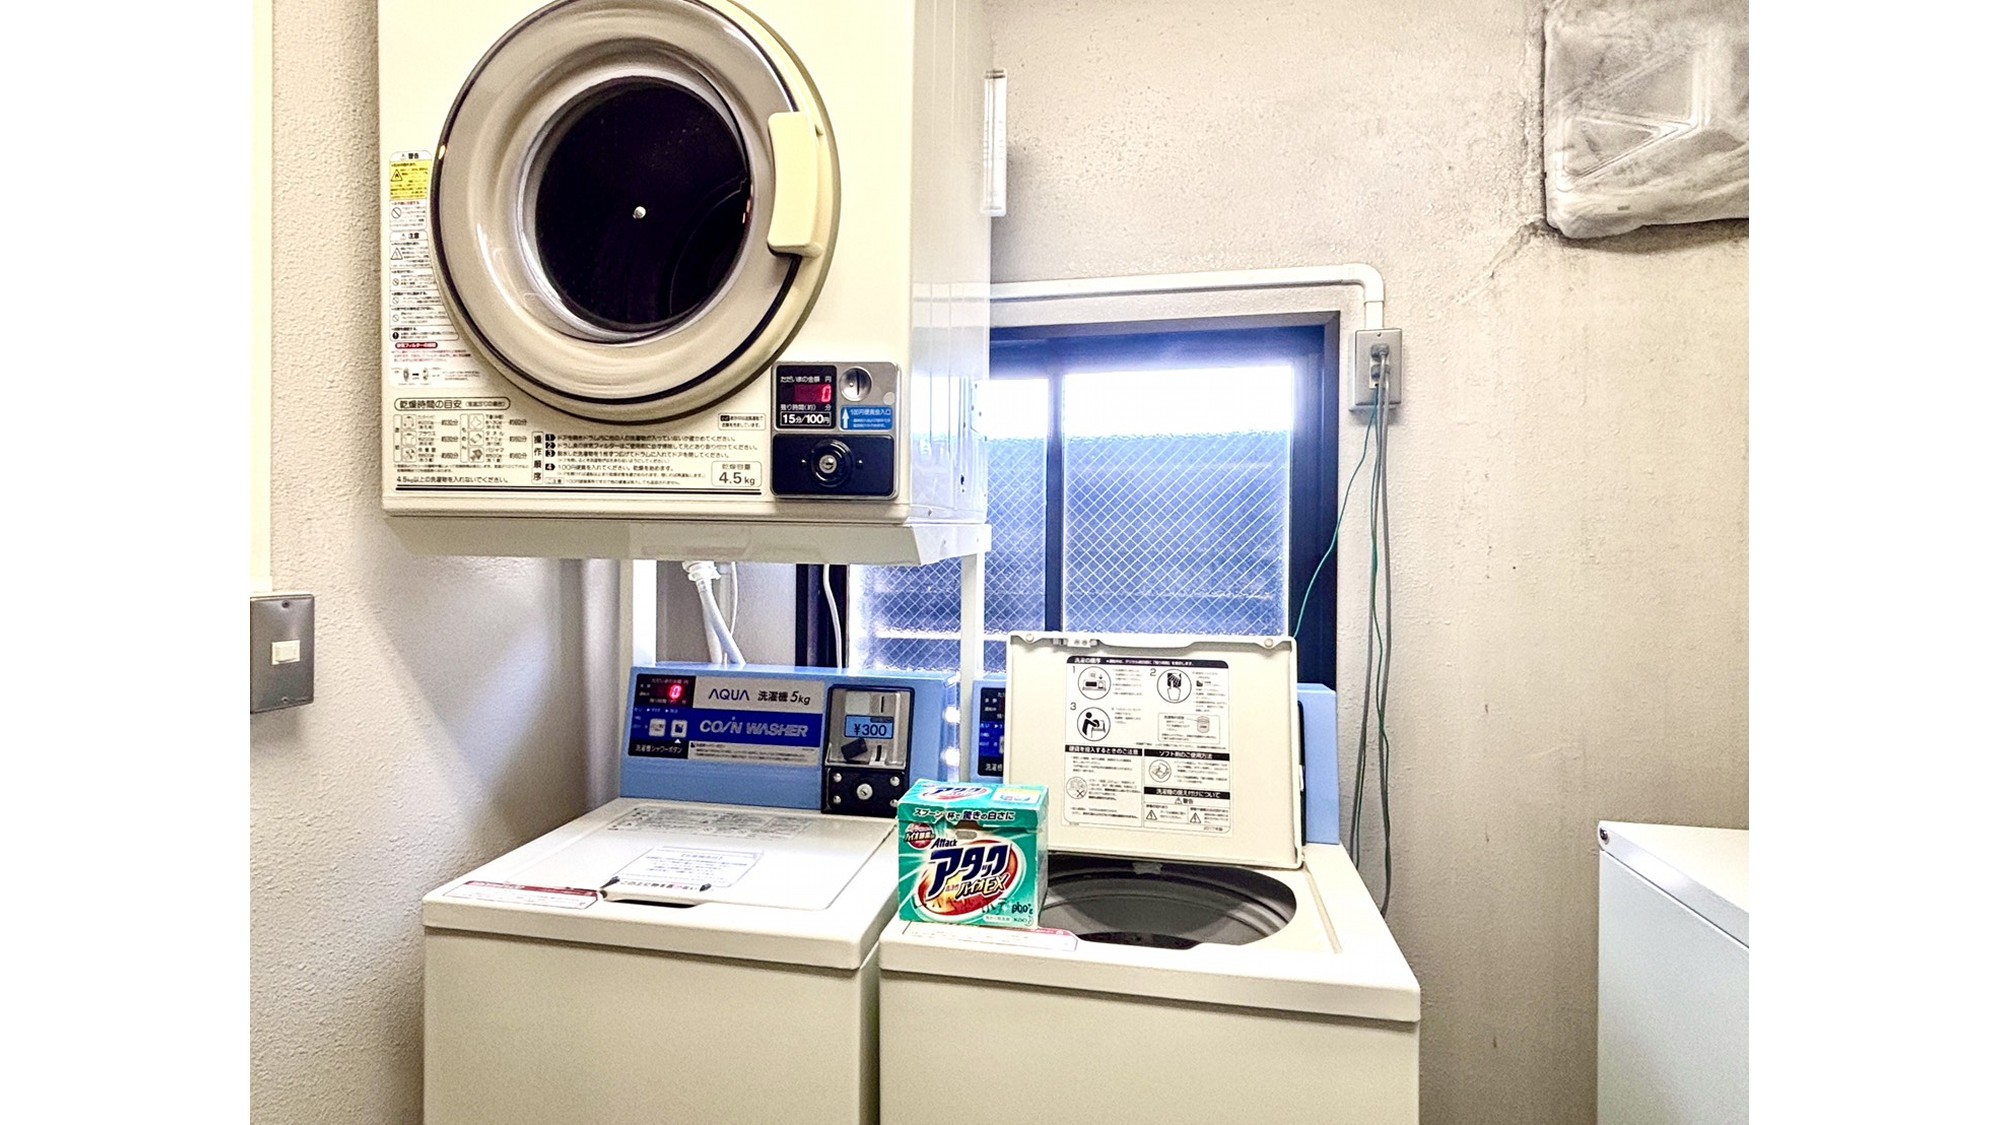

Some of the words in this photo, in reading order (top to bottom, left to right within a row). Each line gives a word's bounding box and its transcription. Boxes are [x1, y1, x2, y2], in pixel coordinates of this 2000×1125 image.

[821, 384, 832, 403] 0
[400, 400, 462, 408] 乾燥時間の目安
[782, 414, 830, 424] 15分/100円
[719, 472, 742, 484] 4.5
[744, 476, 755, 486] kg
[1072, 665, 1076, 673] 1
[1150, 668, 1157, 677] 2
[708, 690, 750, 701] AQUA
[758, 690, 788, 702] 洗濯機
[1070, 702, 1077, 711] 3
[746, 722, 809, 737] WASHER
[854, 723, 887, 736] ¥300
[930, 838, 958, 849] Attack
[928, 845, 1008, 897] アタック
[955, 874, 1009, 899] バイオEX
